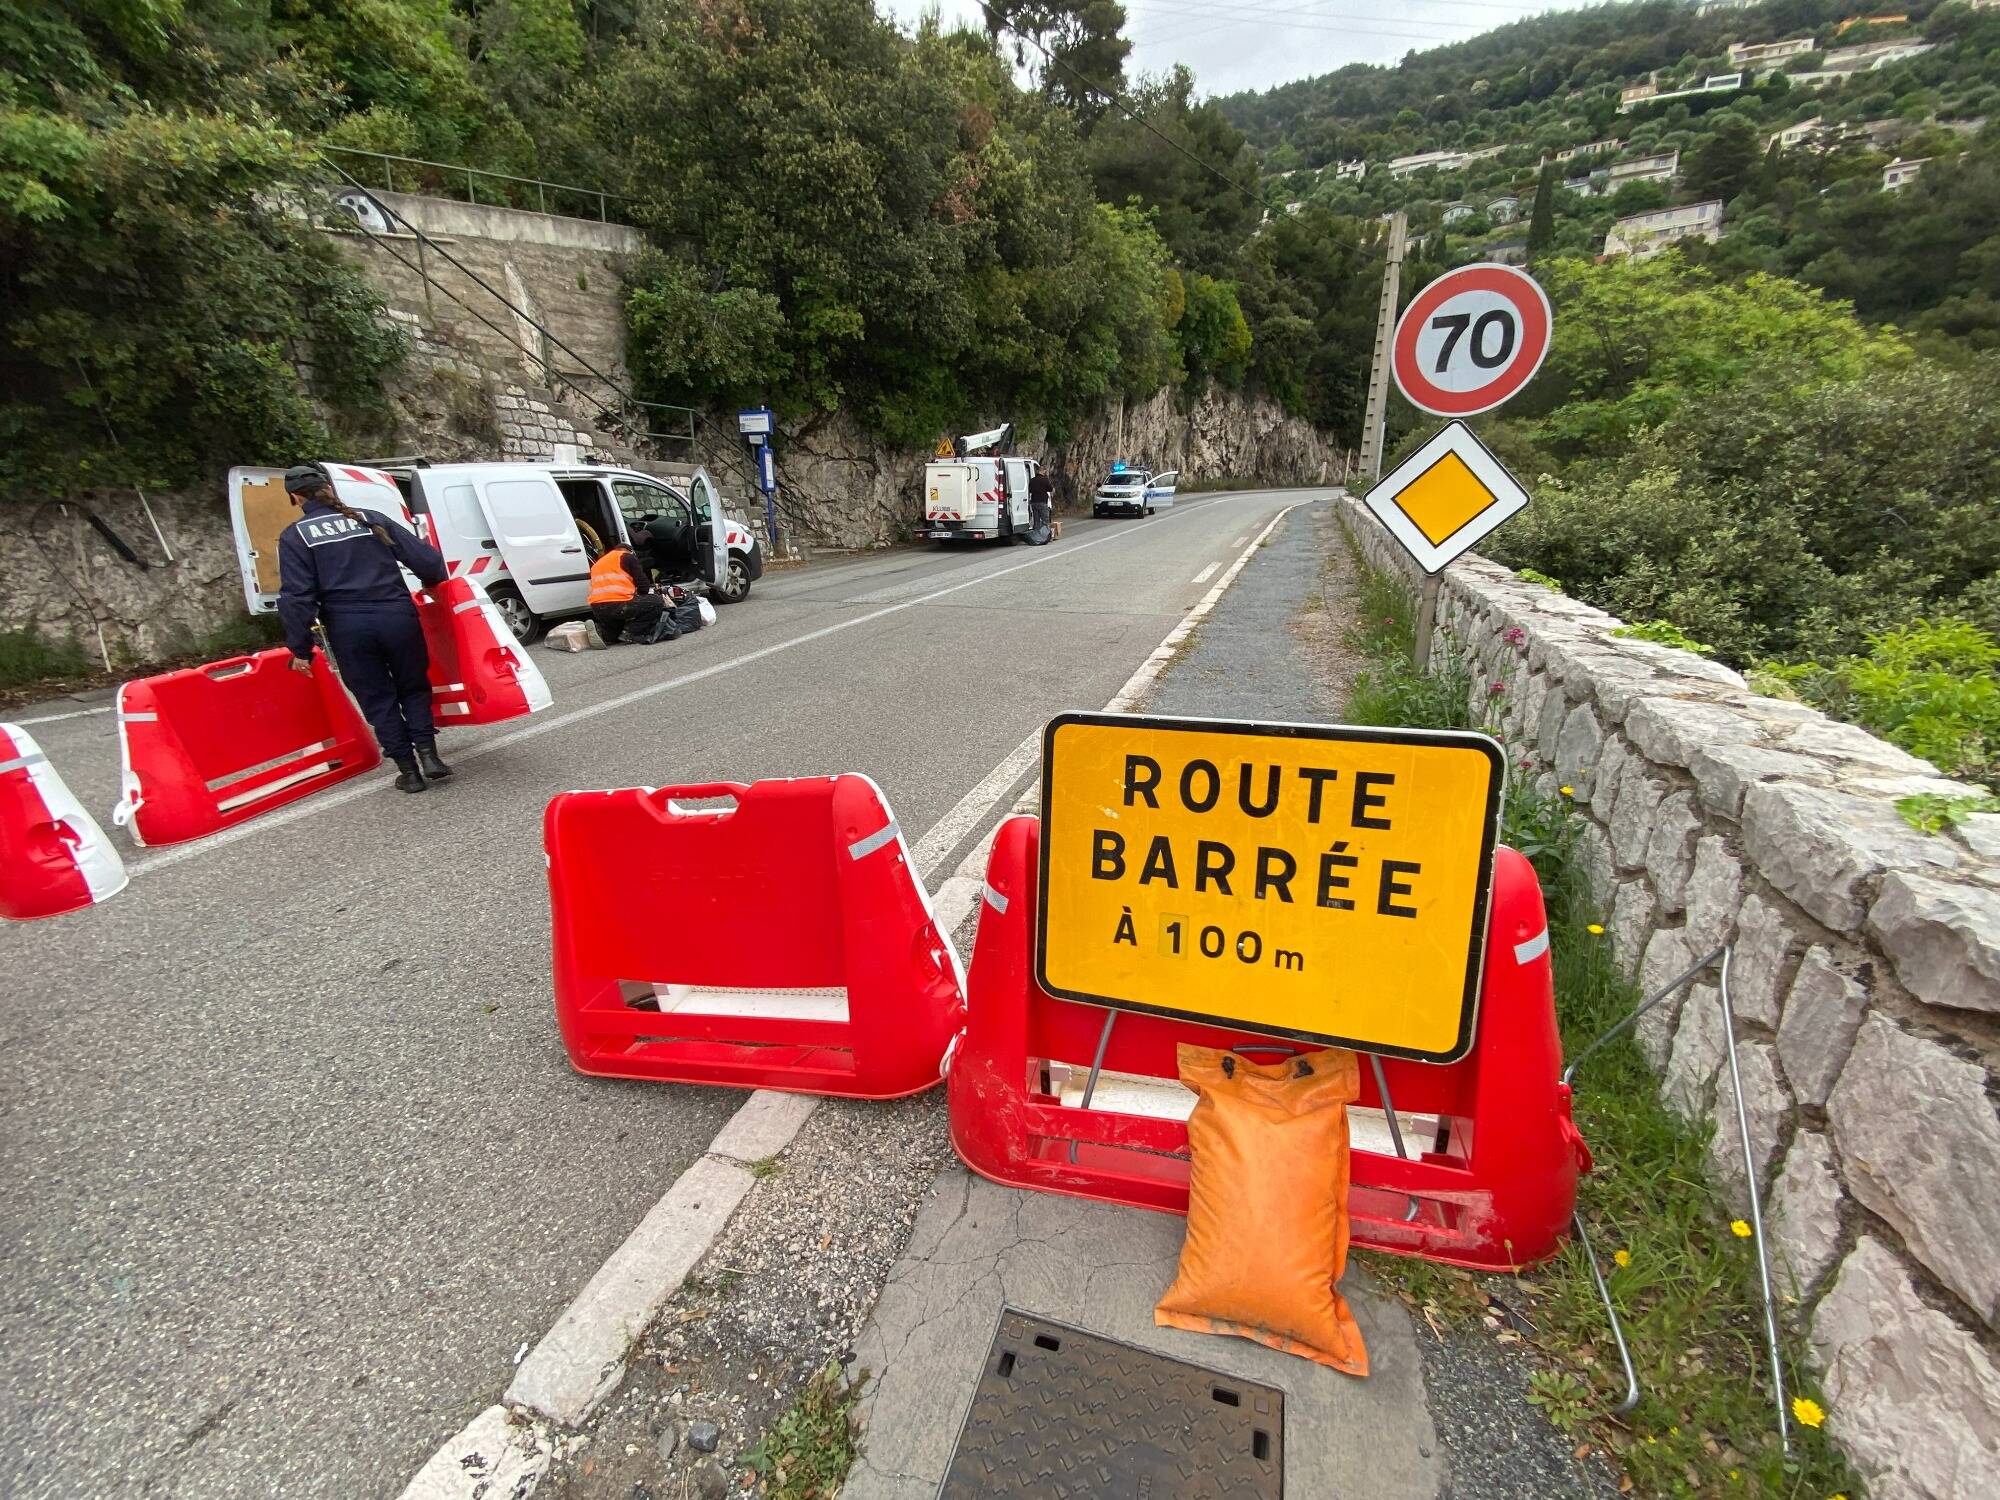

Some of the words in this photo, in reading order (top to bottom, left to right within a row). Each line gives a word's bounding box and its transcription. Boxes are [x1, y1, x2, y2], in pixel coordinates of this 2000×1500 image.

[1431, 309, 1515, 374] 70
[308, 518, 361, 538] A.S.V.P.
[1123, 754, 1396, 831] ROUTE
[1091, 829, 1422, 919] BARRÉE
[1113, 906, 1138, 947] À
